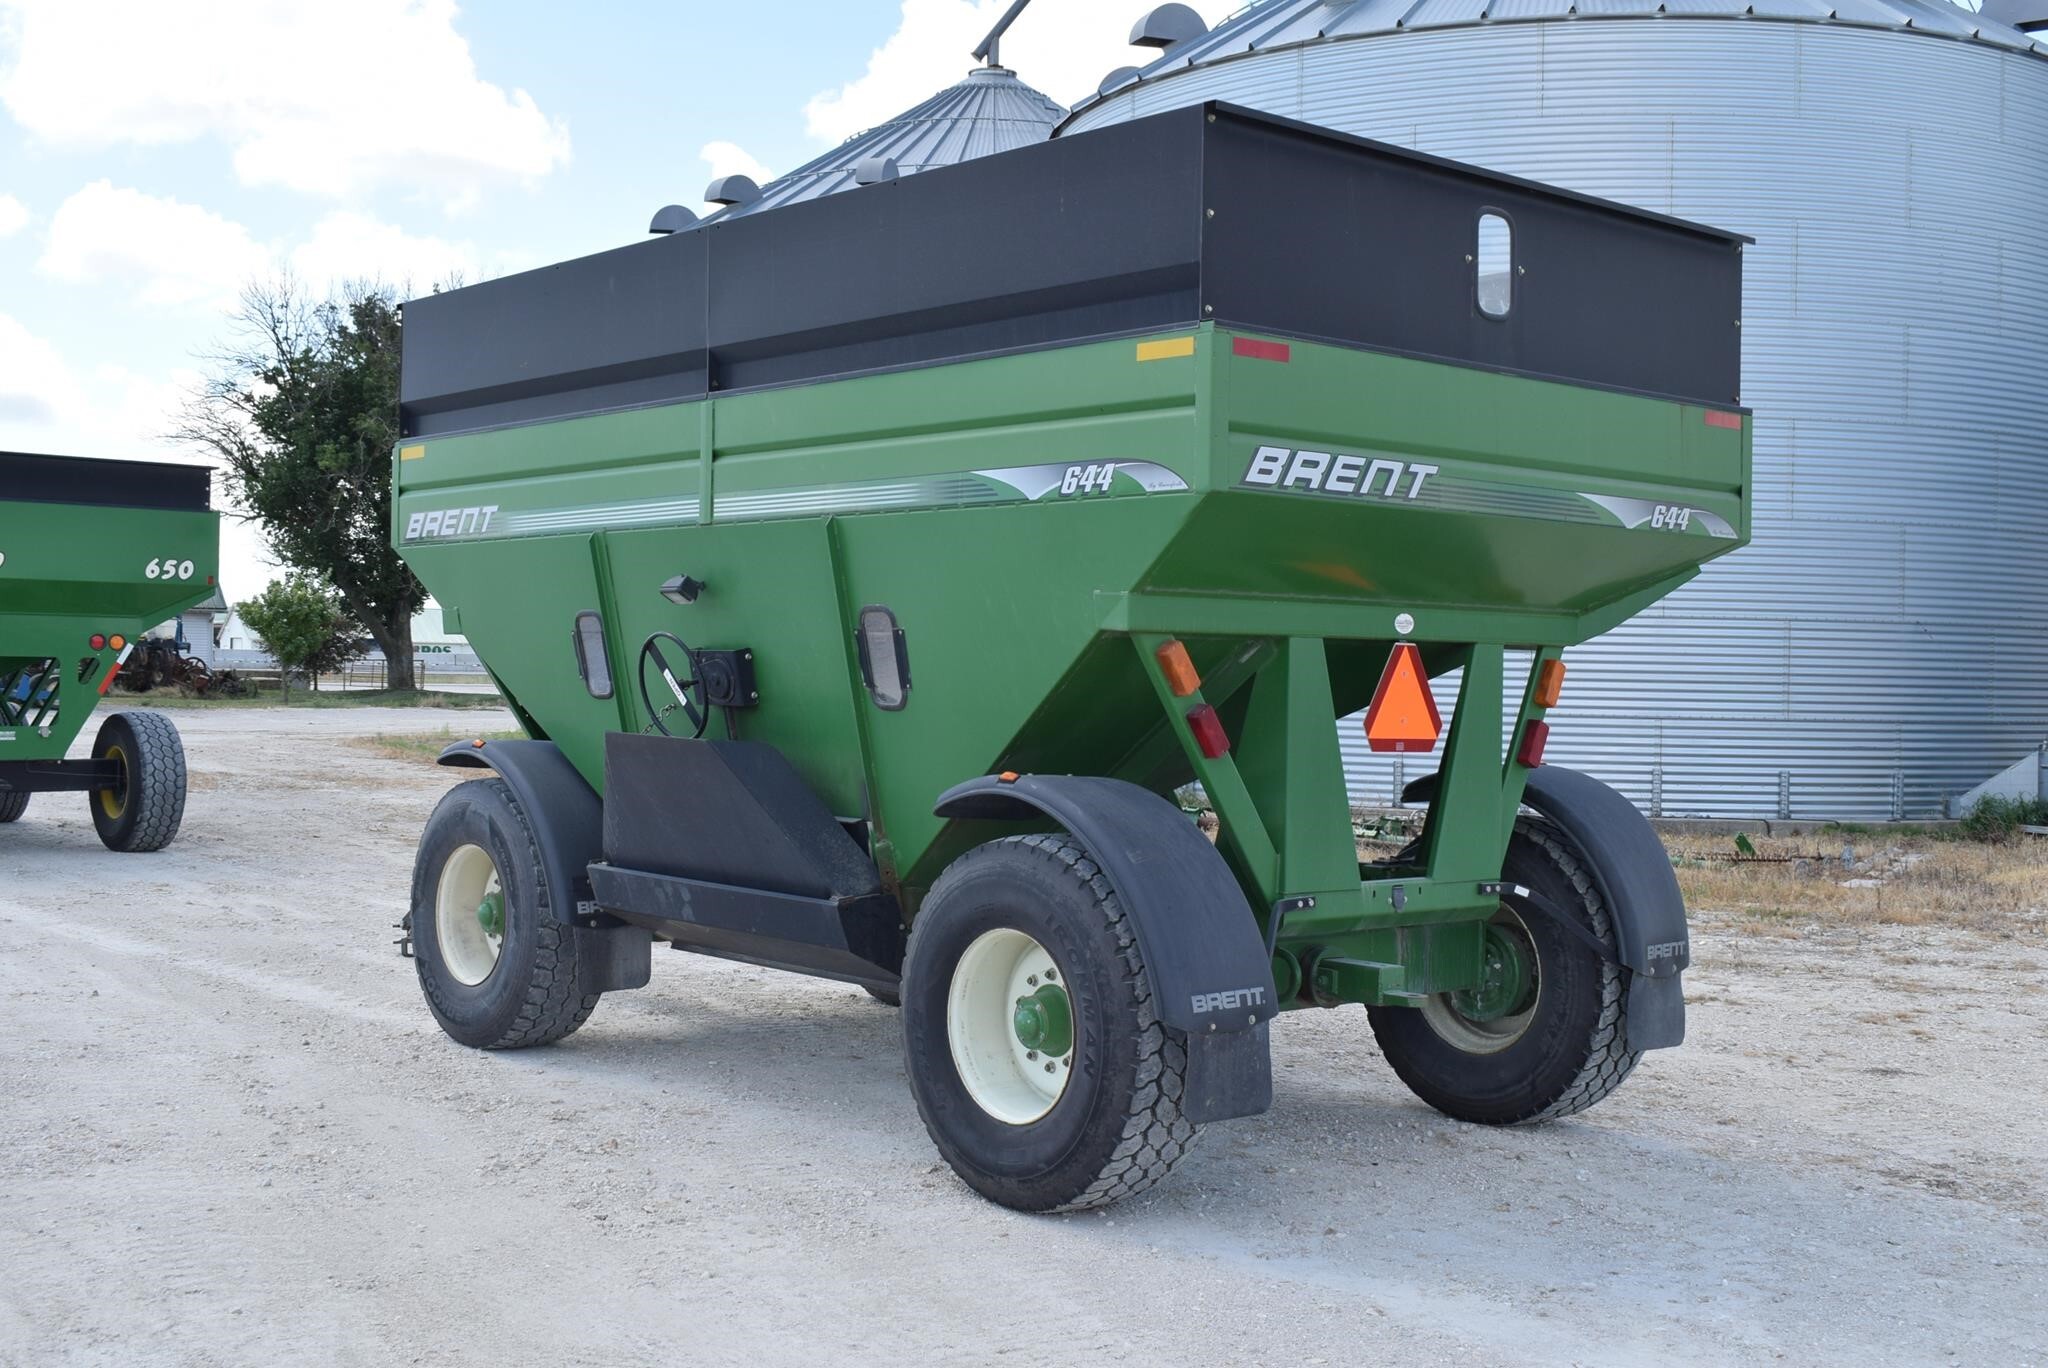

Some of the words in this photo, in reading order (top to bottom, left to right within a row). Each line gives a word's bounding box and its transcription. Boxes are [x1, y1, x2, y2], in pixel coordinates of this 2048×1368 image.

[1060, 462, 1116, 497] 644
[1242, 445, 1440, 500] BRENT
[404, 504, 500, 540] BRENT
[1650, 504, 1692, 532] 644
[144, 557, 195, 580] 650
[1647, 941, 1685, 960] BRENT
